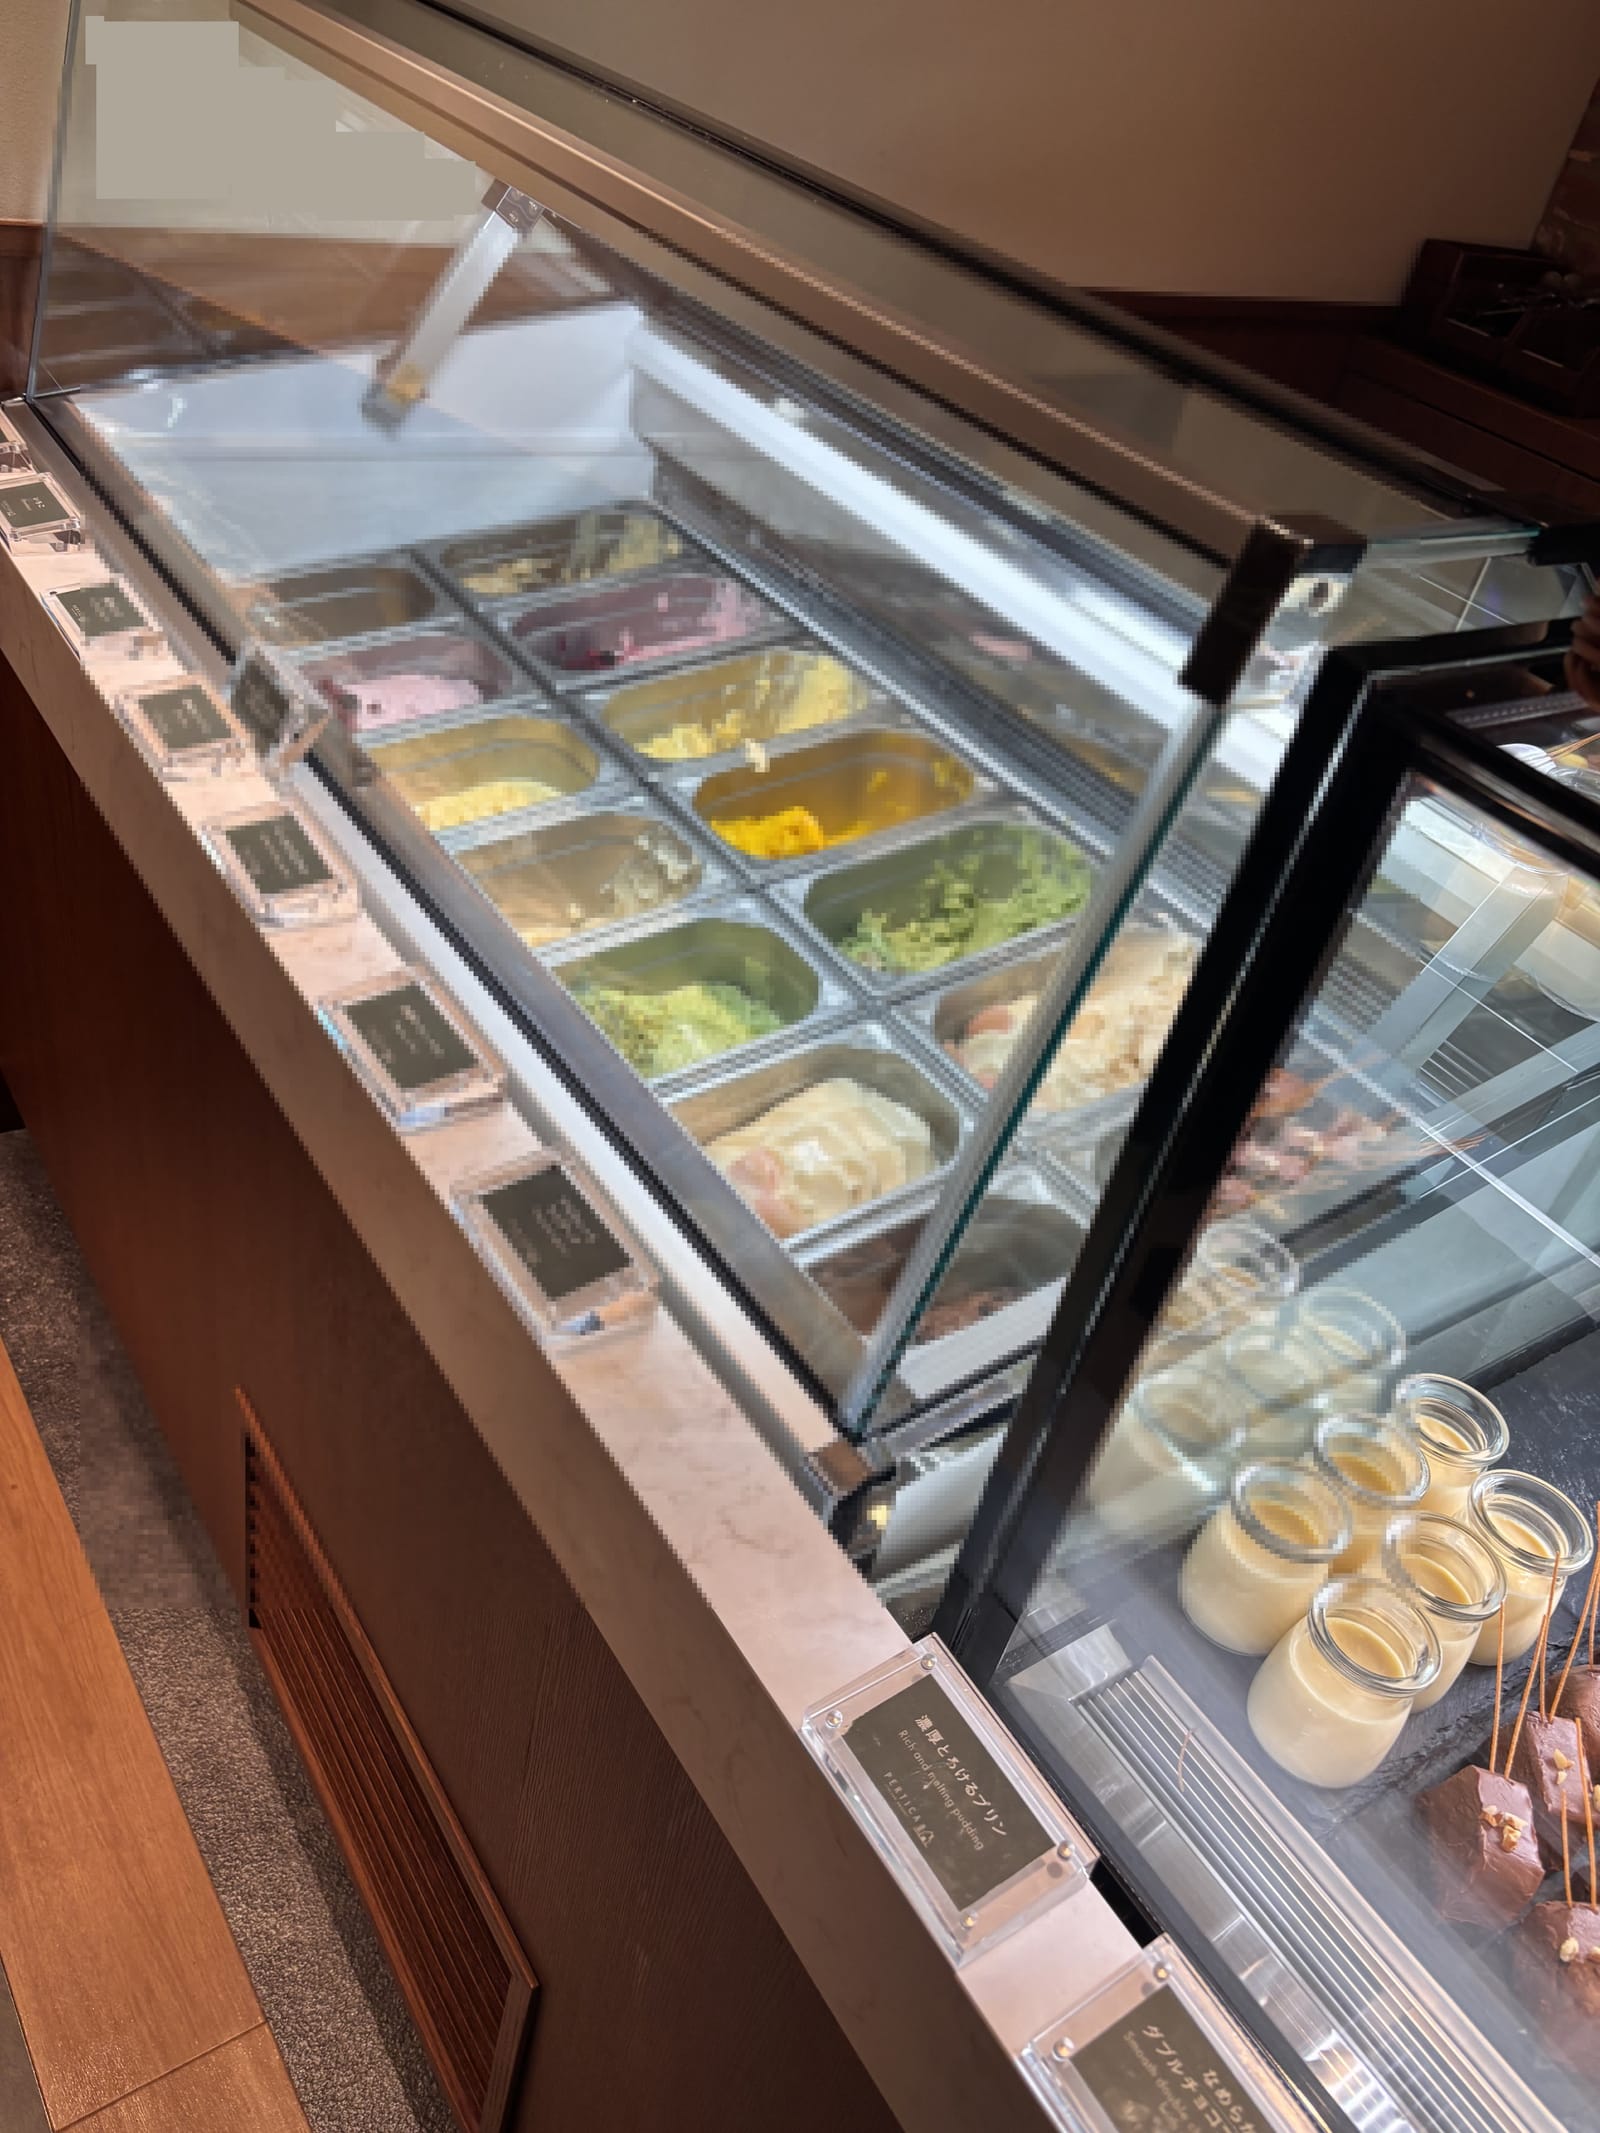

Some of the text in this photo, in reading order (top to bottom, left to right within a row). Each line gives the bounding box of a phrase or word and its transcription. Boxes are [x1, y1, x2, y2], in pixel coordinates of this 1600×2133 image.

[898, 1729, 917, 1752] Rich
[913, 1752, 933, 1771] and
[950, 1808, 984, 1850] pudding
[914, 1714, 1007, 1836] 濃厚とろけるプリン
[1142, 2025, 1232, 2133] ダブルチョコ
